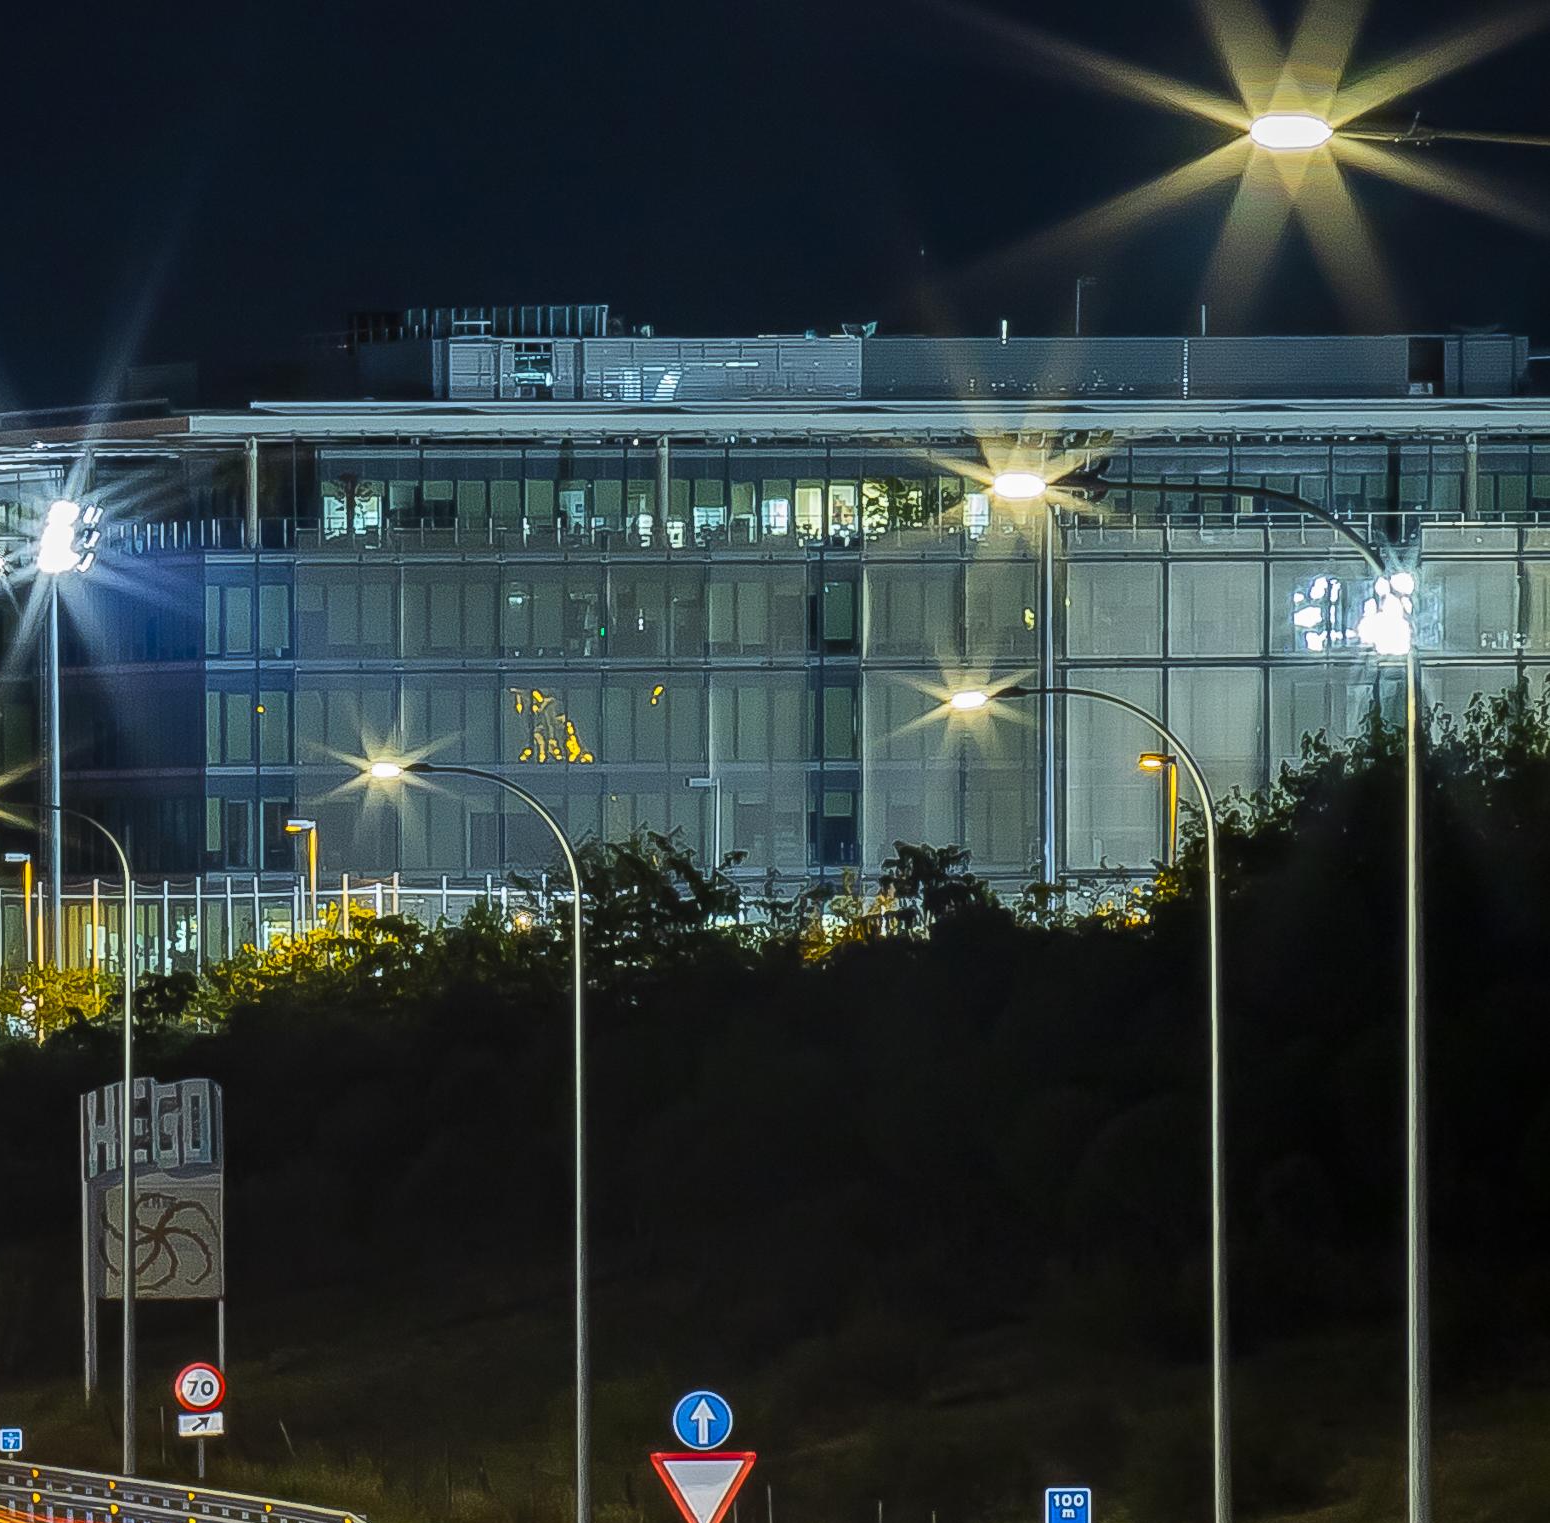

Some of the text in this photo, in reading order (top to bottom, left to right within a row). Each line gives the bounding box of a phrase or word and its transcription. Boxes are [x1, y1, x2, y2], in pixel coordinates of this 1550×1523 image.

[186, 1379, 215, 1397] 70
[1053, 1493, 1085, 1508] 100
[1061, 1508, 1076, 1519] m
